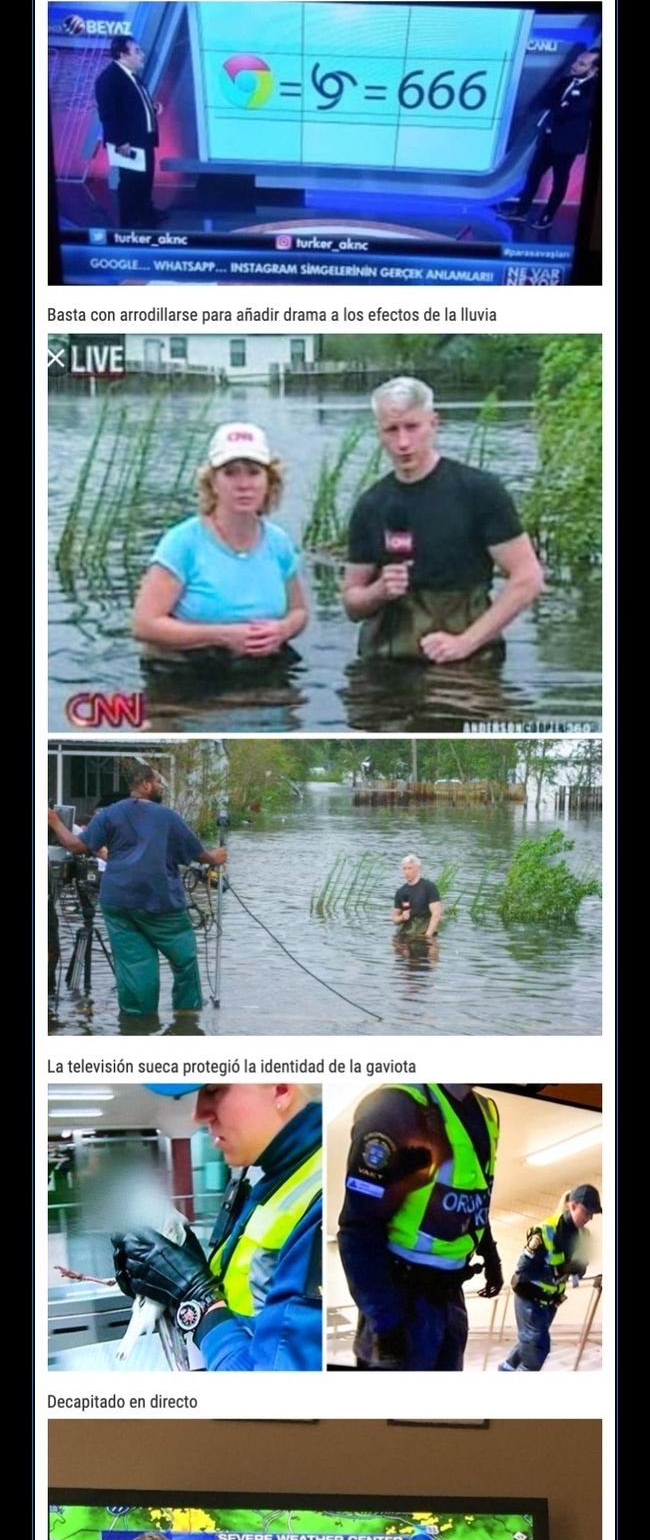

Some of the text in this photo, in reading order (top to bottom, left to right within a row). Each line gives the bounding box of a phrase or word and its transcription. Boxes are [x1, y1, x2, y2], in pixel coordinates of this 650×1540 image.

[87, 20, 132, 34] BEYAZ
[398, 70, 487, 110] 666
[114, 232, 188, 247] turker_aknc
